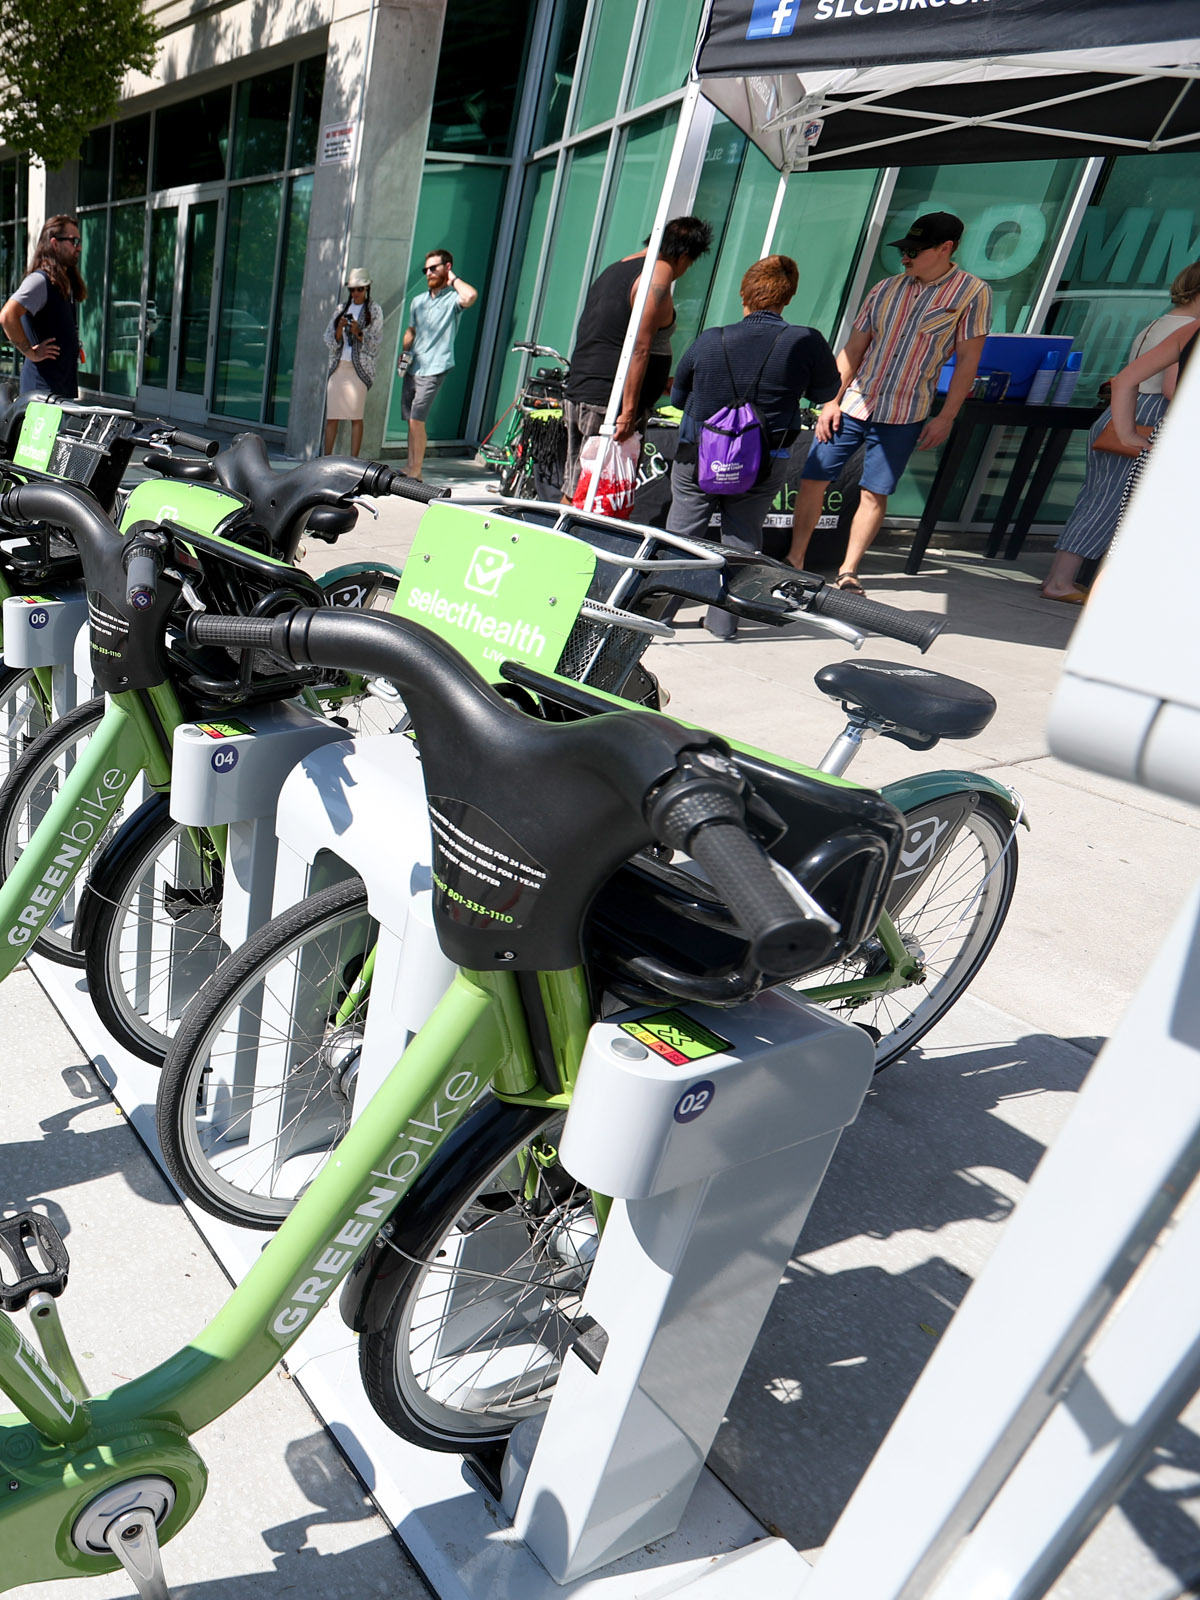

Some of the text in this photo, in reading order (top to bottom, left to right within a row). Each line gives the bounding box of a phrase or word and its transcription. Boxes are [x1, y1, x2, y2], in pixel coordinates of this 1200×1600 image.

[31, 613, 46, 624] 06
[408, 587, 546, 657] selecthealth
[214, 752, 234, 766] 04
[8, 768, 126, 946] GREENbike
[444, 850, 460, 865] EVERY
[459, 862, 478, 876] HOUR
[476, 872, 501, 887] AFTER
[474, 840, 494, 856] RIDES
[494, 851, 510, 863] FOR
[509, 858, 519, 868] 24
[520, 864, 547, 879] HOURS
[476, 857, 497, 872] RIDES
[497, 868, 513, 880] FOR
[519, 877, 541, 890] YEAR
[448, 888, 514, 924] 801-333-1110
[679, 1090, 710, 1114] 02
[274, 1071, 478, 1334] GREENbike
